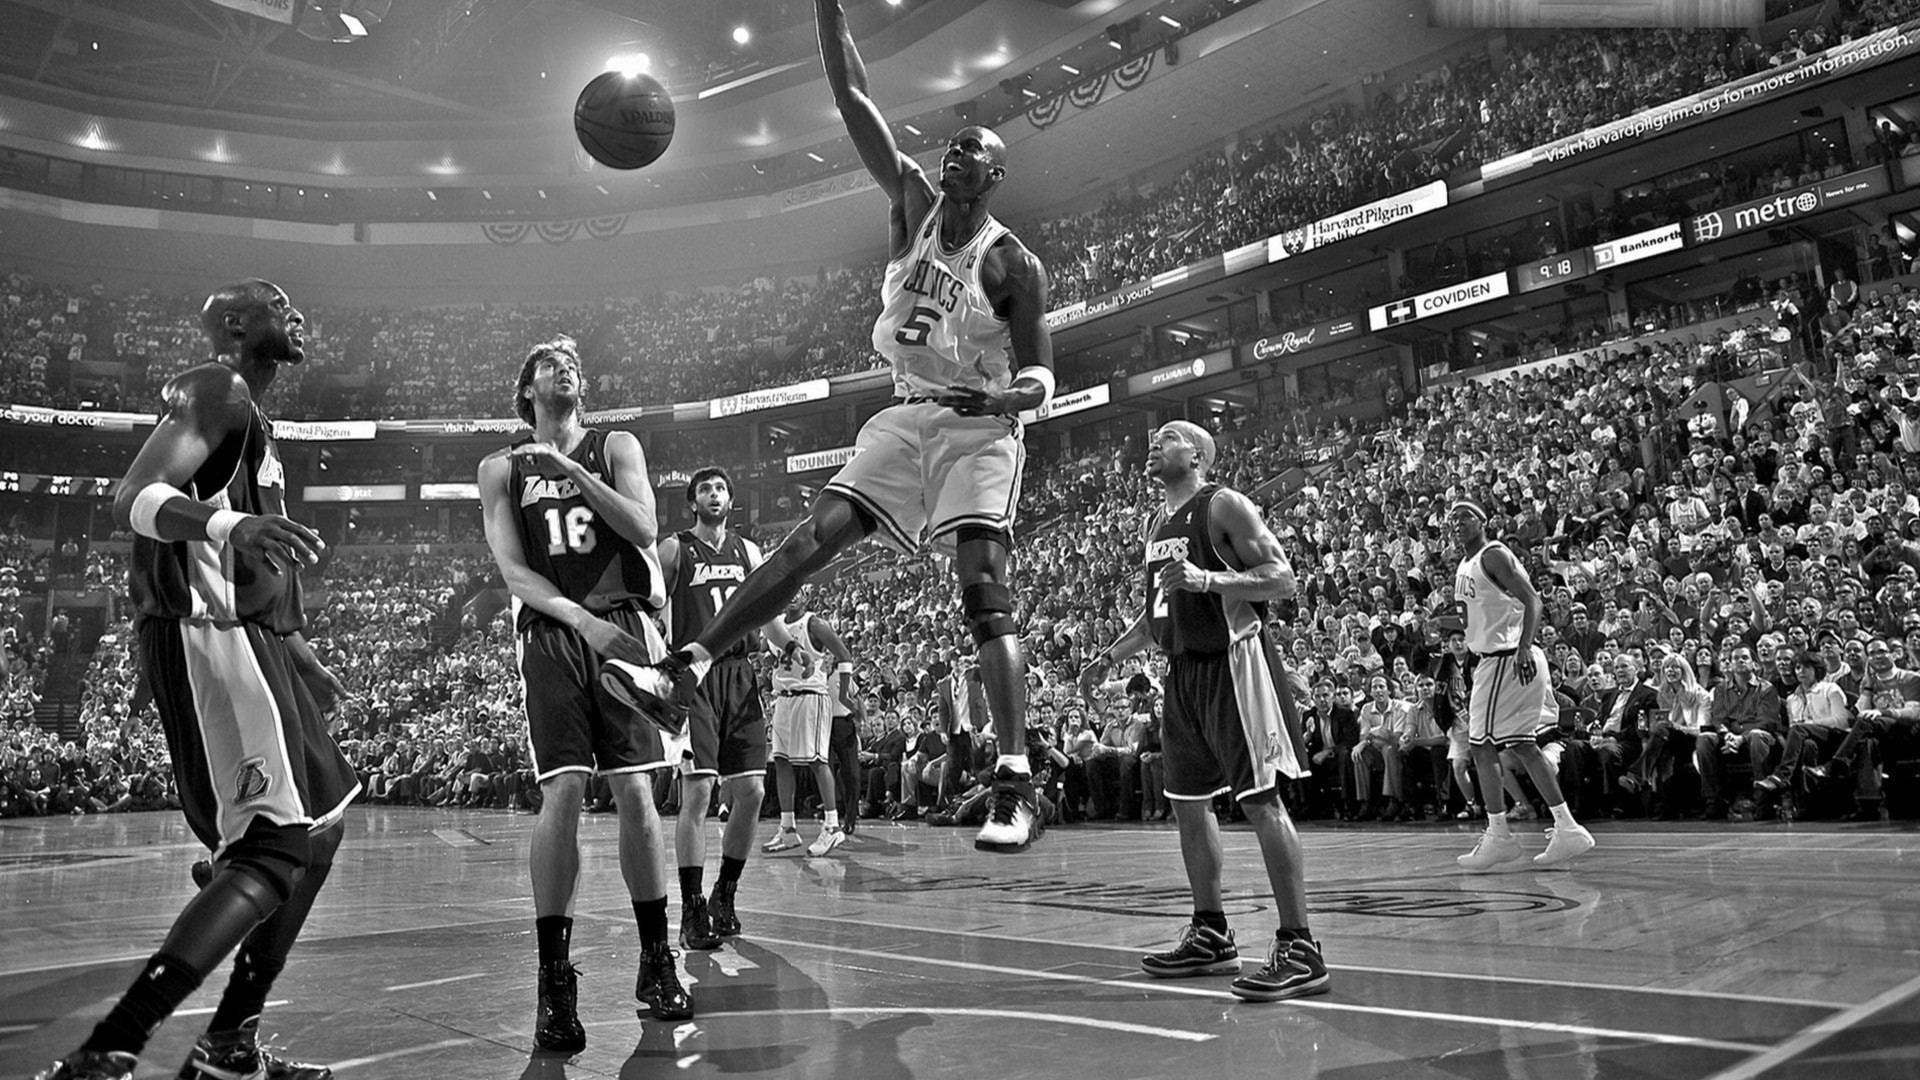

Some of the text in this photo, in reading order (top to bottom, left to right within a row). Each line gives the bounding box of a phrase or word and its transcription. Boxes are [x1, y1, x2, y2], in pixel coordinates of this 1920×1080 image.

[1545, 34, 1914, 162] Visit harvardpilgrim.org for more information.
[1313, 211, 1364, 235] Harvard
[1366, 204, 1414, 225] Pilgrim
[1620, 230, 1683, 254] Banknorth
[1540, 260, 1572, 278] 9:18
[1423, 282, 1491, 311] COVIDIEN
[896, 306, 942, 346] 5
[23, 410, 54, 424] your
[57, 413, 105, 427] doctor.
[521, 472, 601, 508] LAKE
[544, 505, 598, 556] 16
[690, 562, 746, 587] LAKERS
